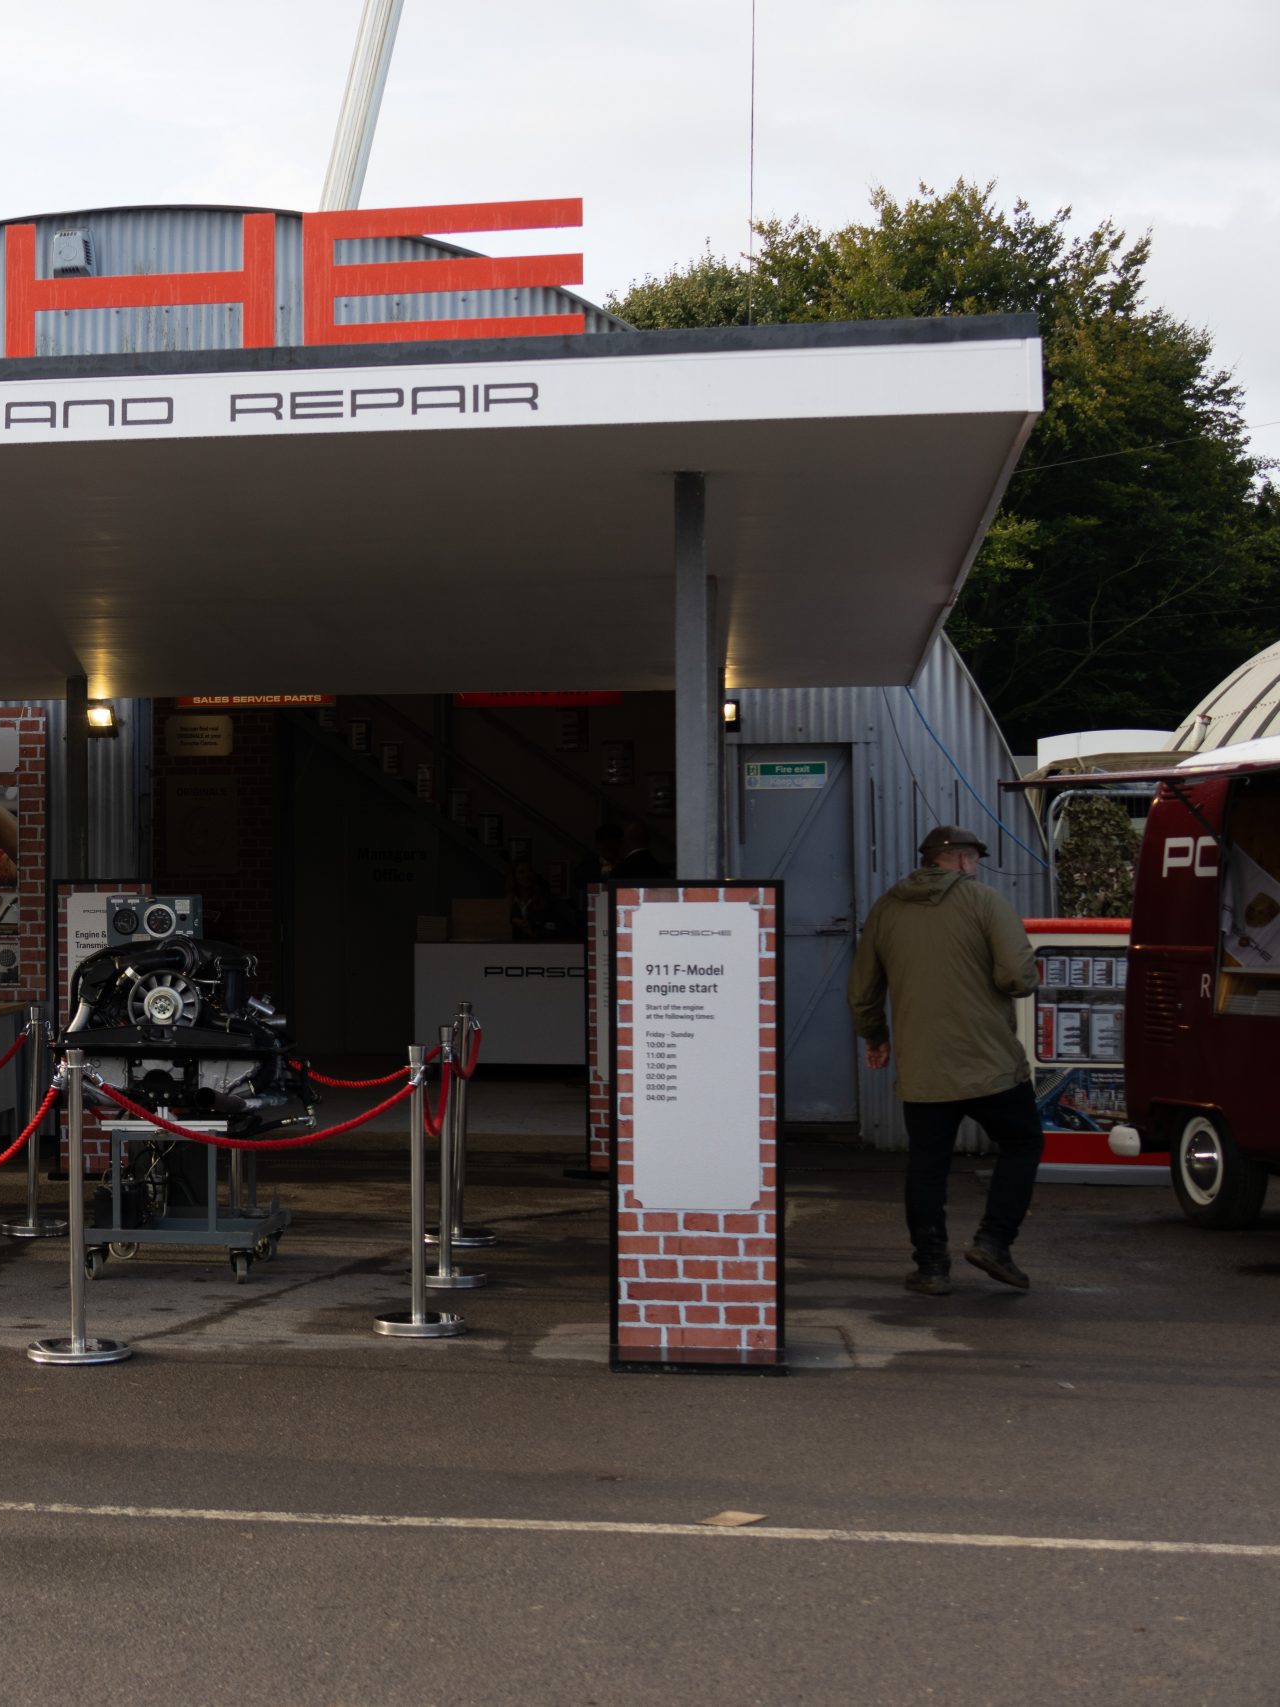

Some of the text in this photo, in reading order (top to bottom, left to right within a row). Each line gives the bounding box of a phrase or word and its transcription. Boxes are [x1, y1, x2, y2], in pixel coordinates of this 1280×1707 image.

[4, 396, 175, 430] AND
[229, 381, 540, 423] REPAIR
[192, 694, 322, 704] SALES SERVICE PARTS
[775, 765, 811, 773] Fire exit
[373, 868, 417, 881] Office
[75, 931, 107, 940] Engine &
[658, 929, 732, 937] PORSCHE
[645, 964, 724, 976] 911 F-Model
[646, 982, 718, 996] engine start
[682, 1004, 704, 1012] engine
[665, 1013, 694, 1021] following
[645, 1031, 665, 1039] Friday
[670, 1031, 695, 1039] Sunday
